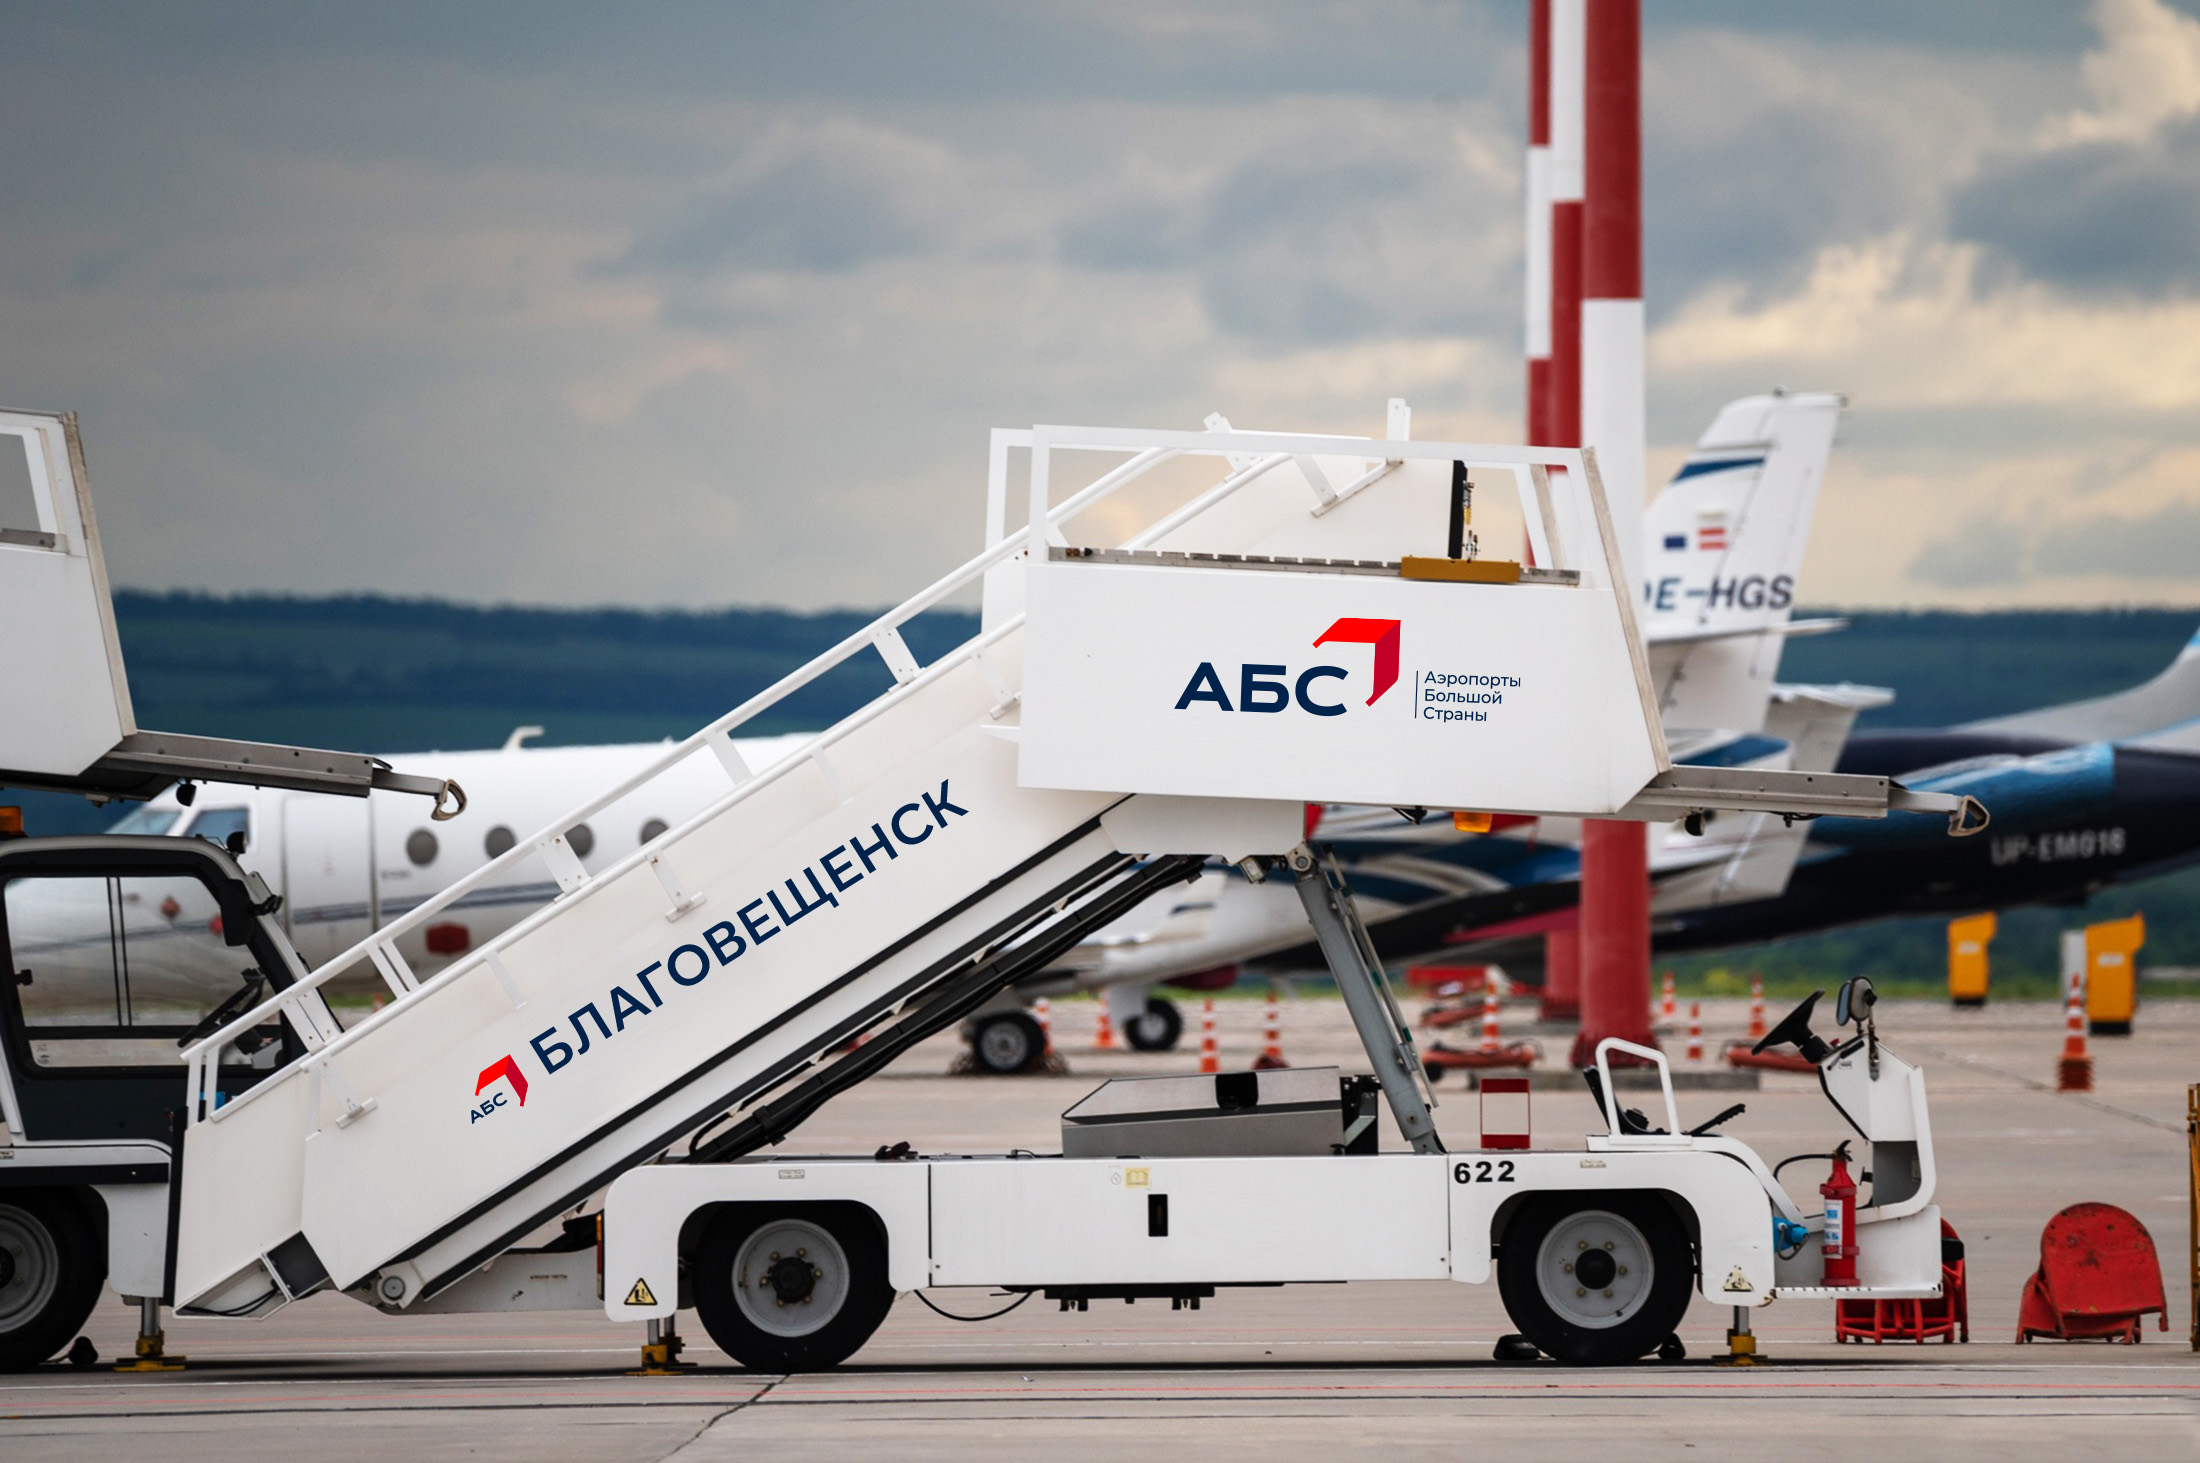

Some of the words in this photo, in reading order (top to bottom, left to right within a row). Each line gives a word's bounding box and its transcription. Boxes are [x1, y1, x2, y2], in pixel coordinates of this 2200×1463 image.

[1174, 661, 1349, 717] АБС
[1424, 670, 1522, 688] Аэропорты
[1424, 688, 1503, 704] Большой
[1423, 706, 1487, 722] Страны
[529, 778, 969, 1075] БЛАГОВЕЩЕНСК
[470, 1092, 508, 1124] АБС
[1453, 1160, 1516, 1184] 622
